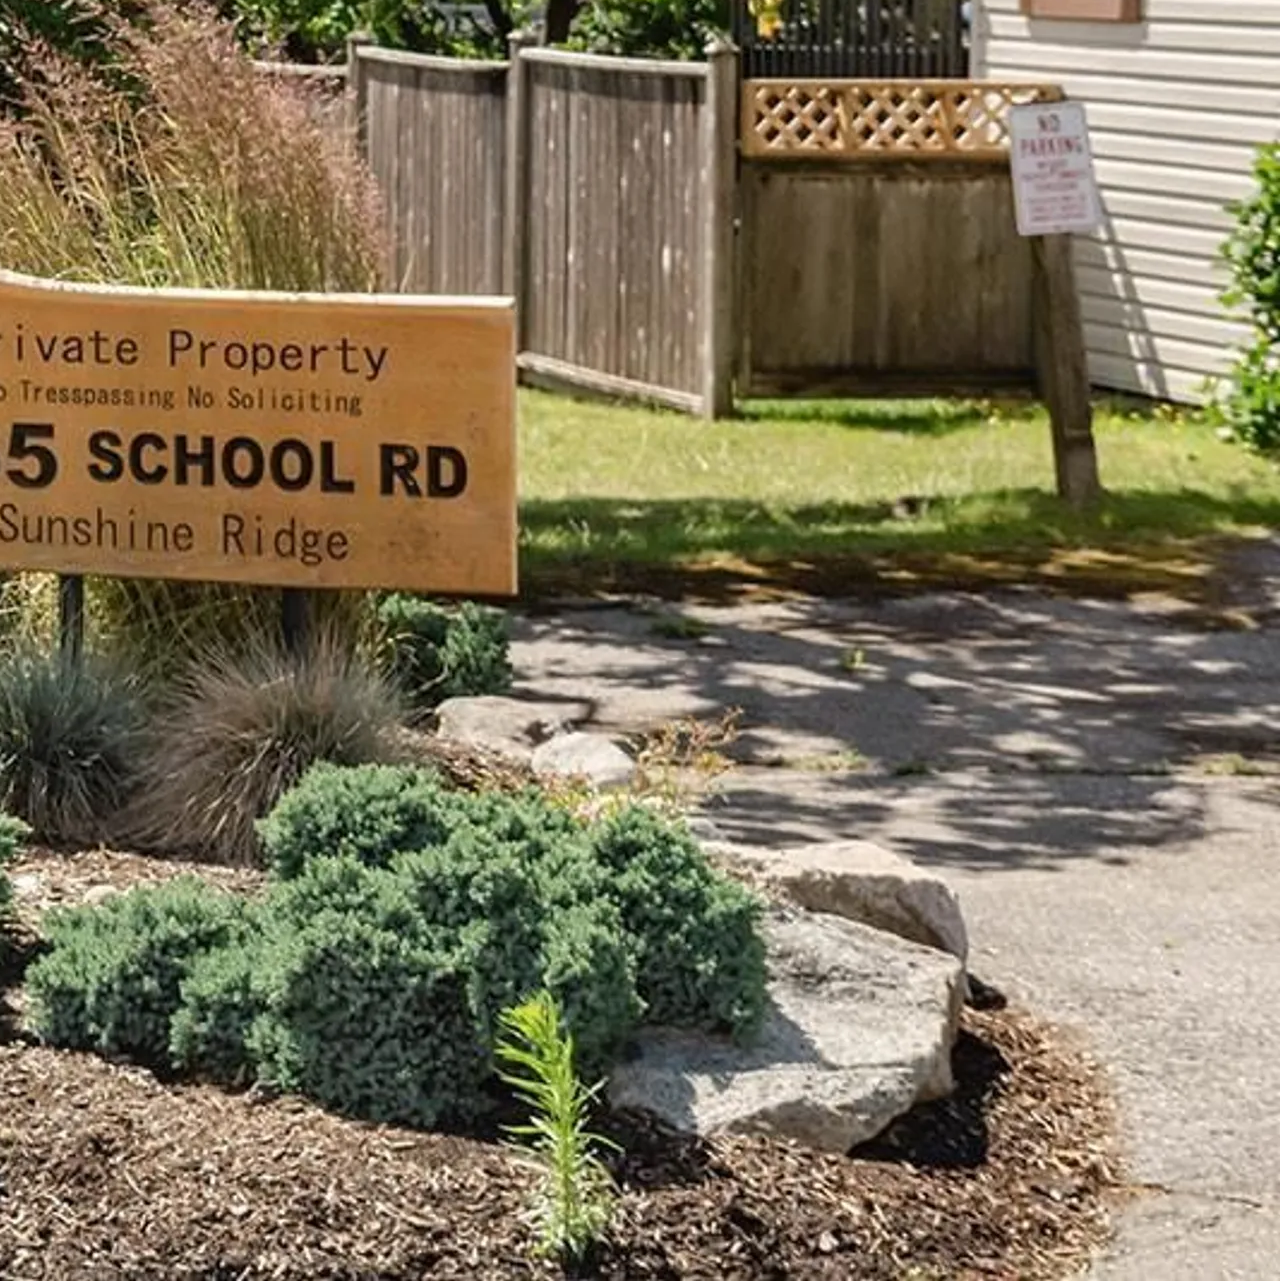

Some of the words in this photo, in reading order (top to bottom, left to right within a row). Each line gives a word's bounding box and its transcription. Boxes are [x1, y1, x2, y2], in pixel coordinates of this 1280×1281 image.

[169, 330, 389, 380] Property
[19, 381, 175, 410] Tresspassing
[187, 385, 213, 409] No
[227, 388, 362, 415] Soliciting
[87, 430, 354, 493] SCHOOL
[380, 443, 467, 498] RD
[222, 515, 349, 564] Ridge
